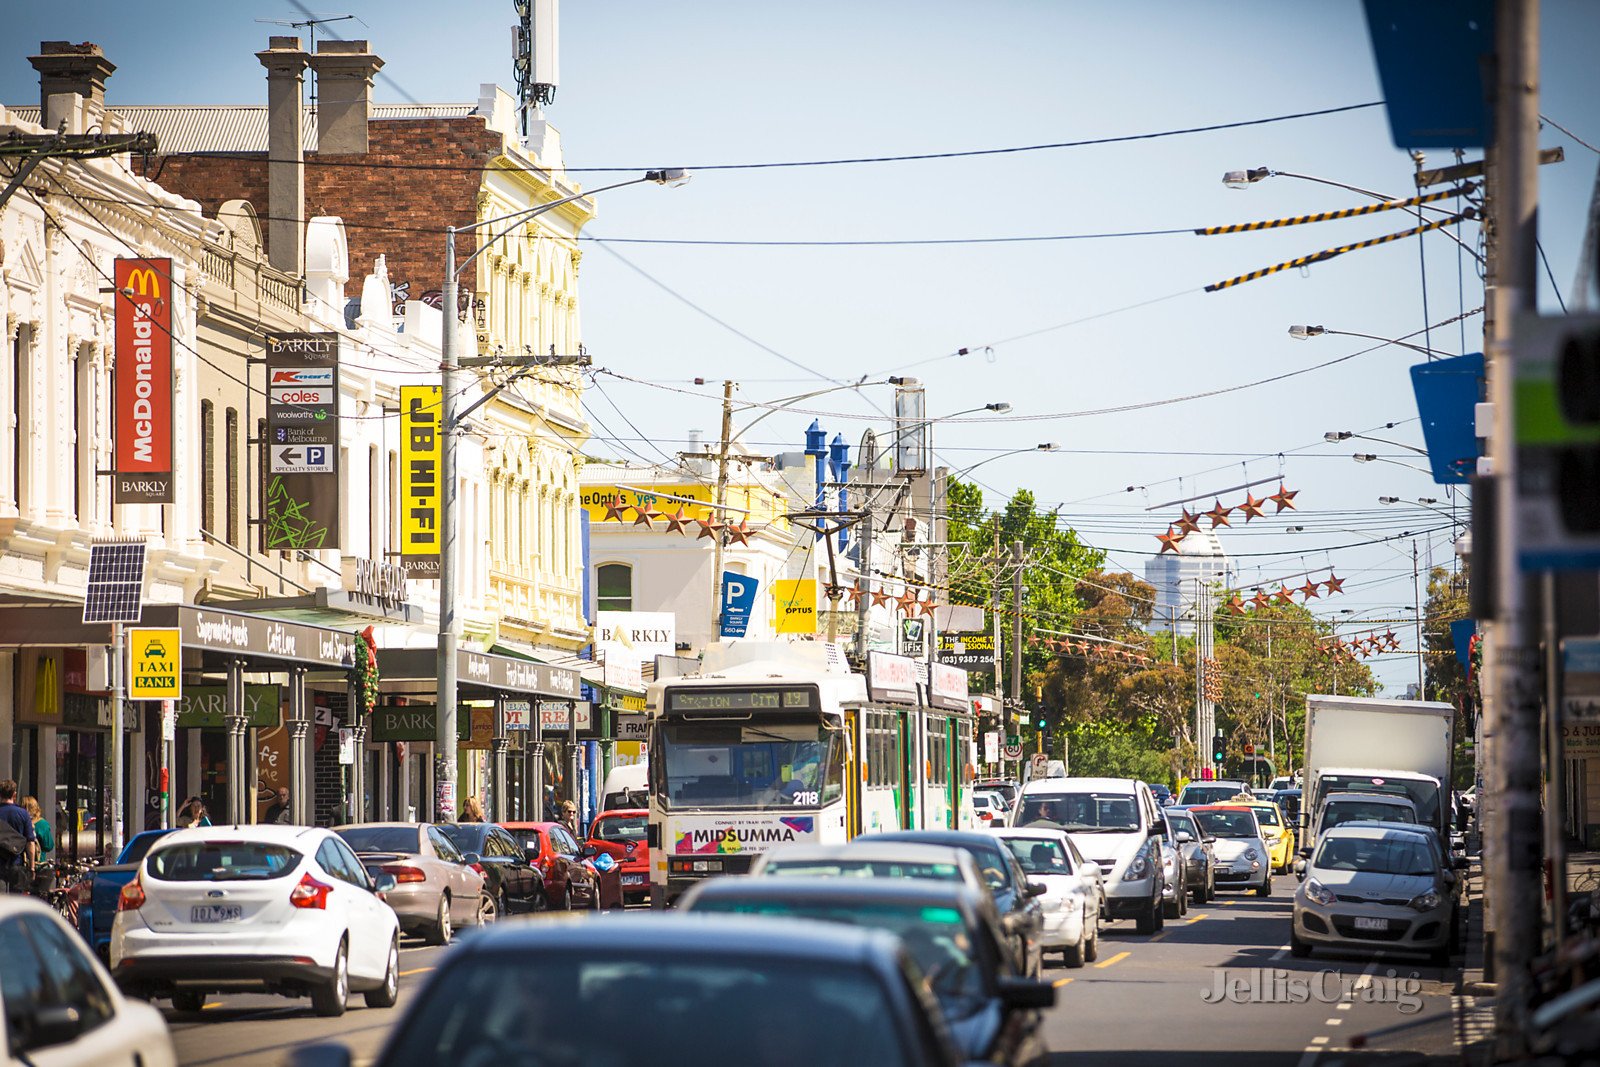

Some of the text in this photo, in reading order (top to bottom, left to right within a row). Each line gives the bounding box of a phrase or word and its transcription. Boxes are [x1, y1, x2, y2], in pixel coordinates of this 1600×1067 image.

[272, 339, 332, 353] BARKLY
[134, 302, 152, 462] McDonald's
[272, 371, 331, 382] Kmart
[281, 390, 319, 403] coles
[276, 411, 313, 420] woolworths
[410, 397, 434, 452] JB
[287, 435, 328, 443] Melbourne
[122, 481, 168, 492] BARKLY
[592, 491, 626, 507] Optus
[667, 491, 695, 507] shop
[405, 561, 440, 570] BARKLY
[727, 582, 745, 604] P
[602, 625, 671, 651] BARKLY
[941, 655, 995, 664] (03) 9387 256
[138, 662, 173, 672] TAXI
[137, 677, 173, 688] RANK
[787, 692, 801, 705] 19
[386, 713, 435, 730] BARK
[793, 791, 818, 804] 2118
[694, 828, 795, 843] MIDSUMMA
